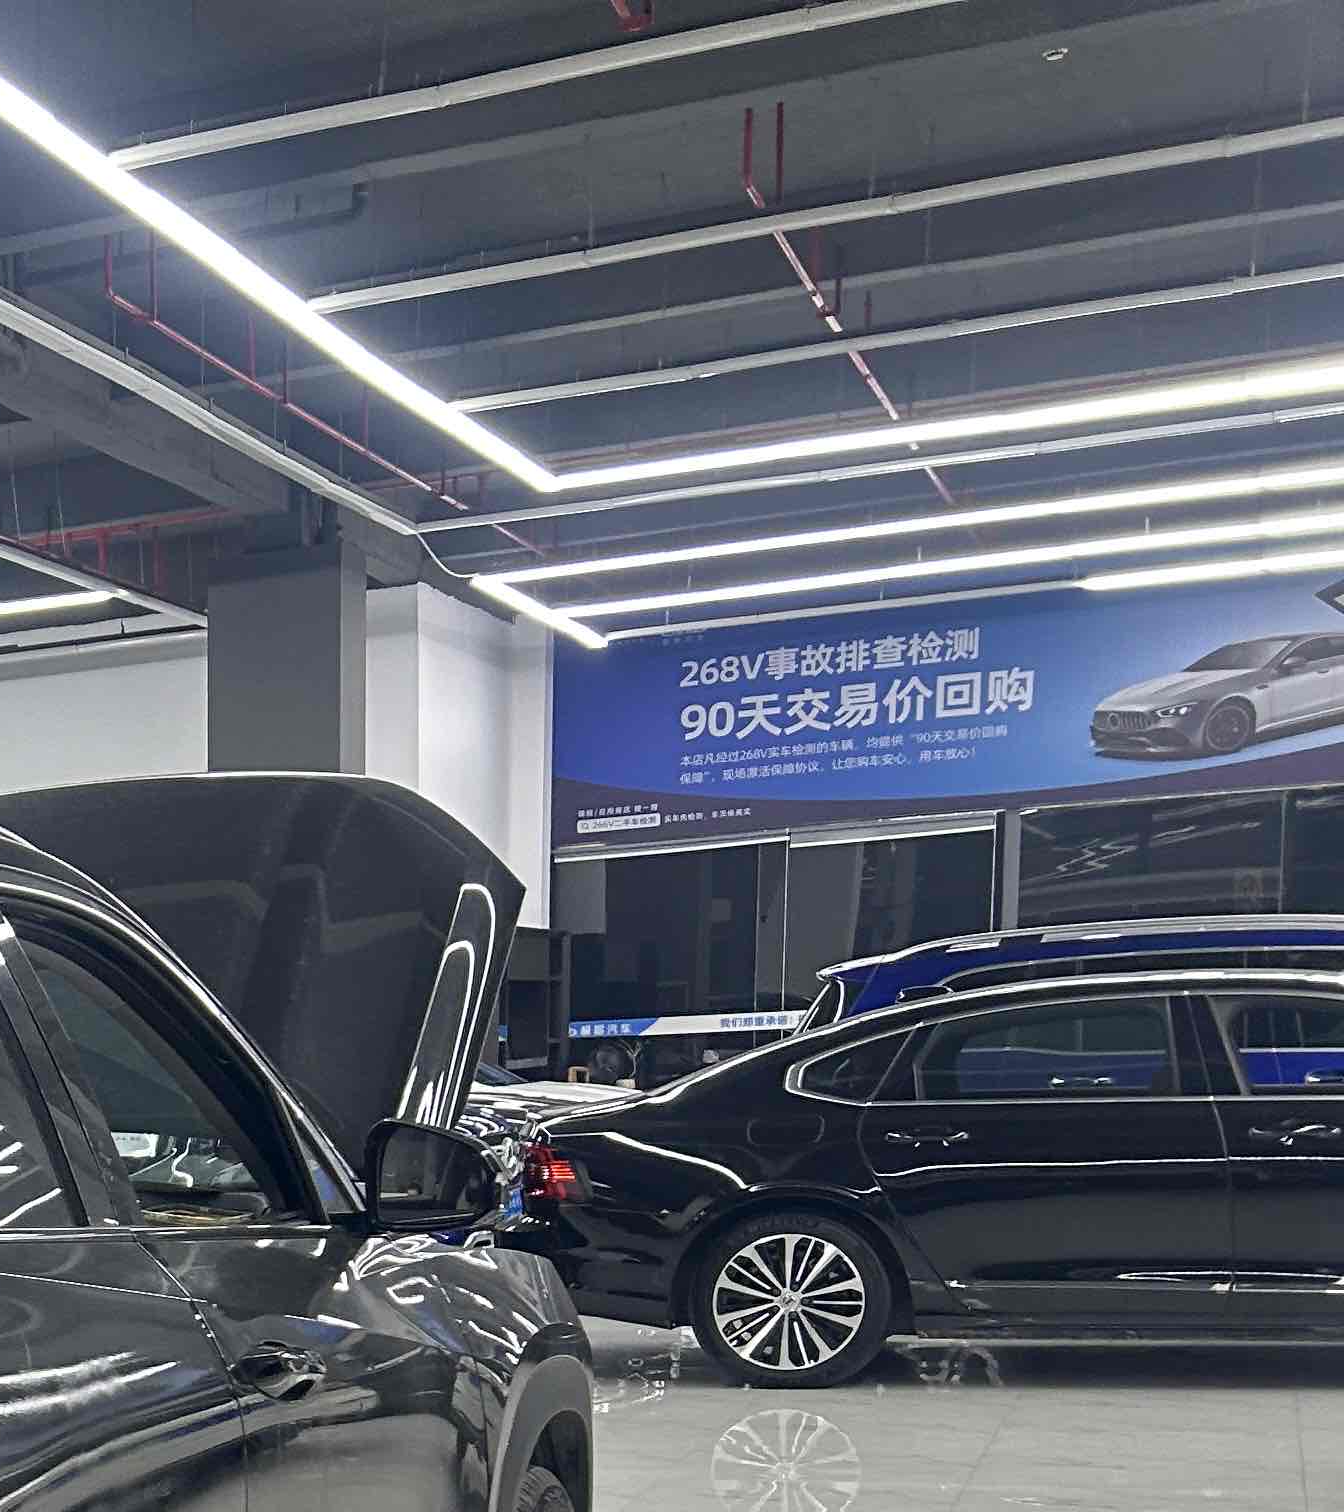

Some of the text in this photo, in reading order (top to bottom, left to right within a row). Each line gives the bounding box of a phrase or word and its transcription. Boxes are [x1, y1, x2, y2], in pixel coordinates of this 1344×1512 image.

[679, 627, 980, 688] 268V事故排查检测
[680, 666, 1035, 741] 90天交易价回购
